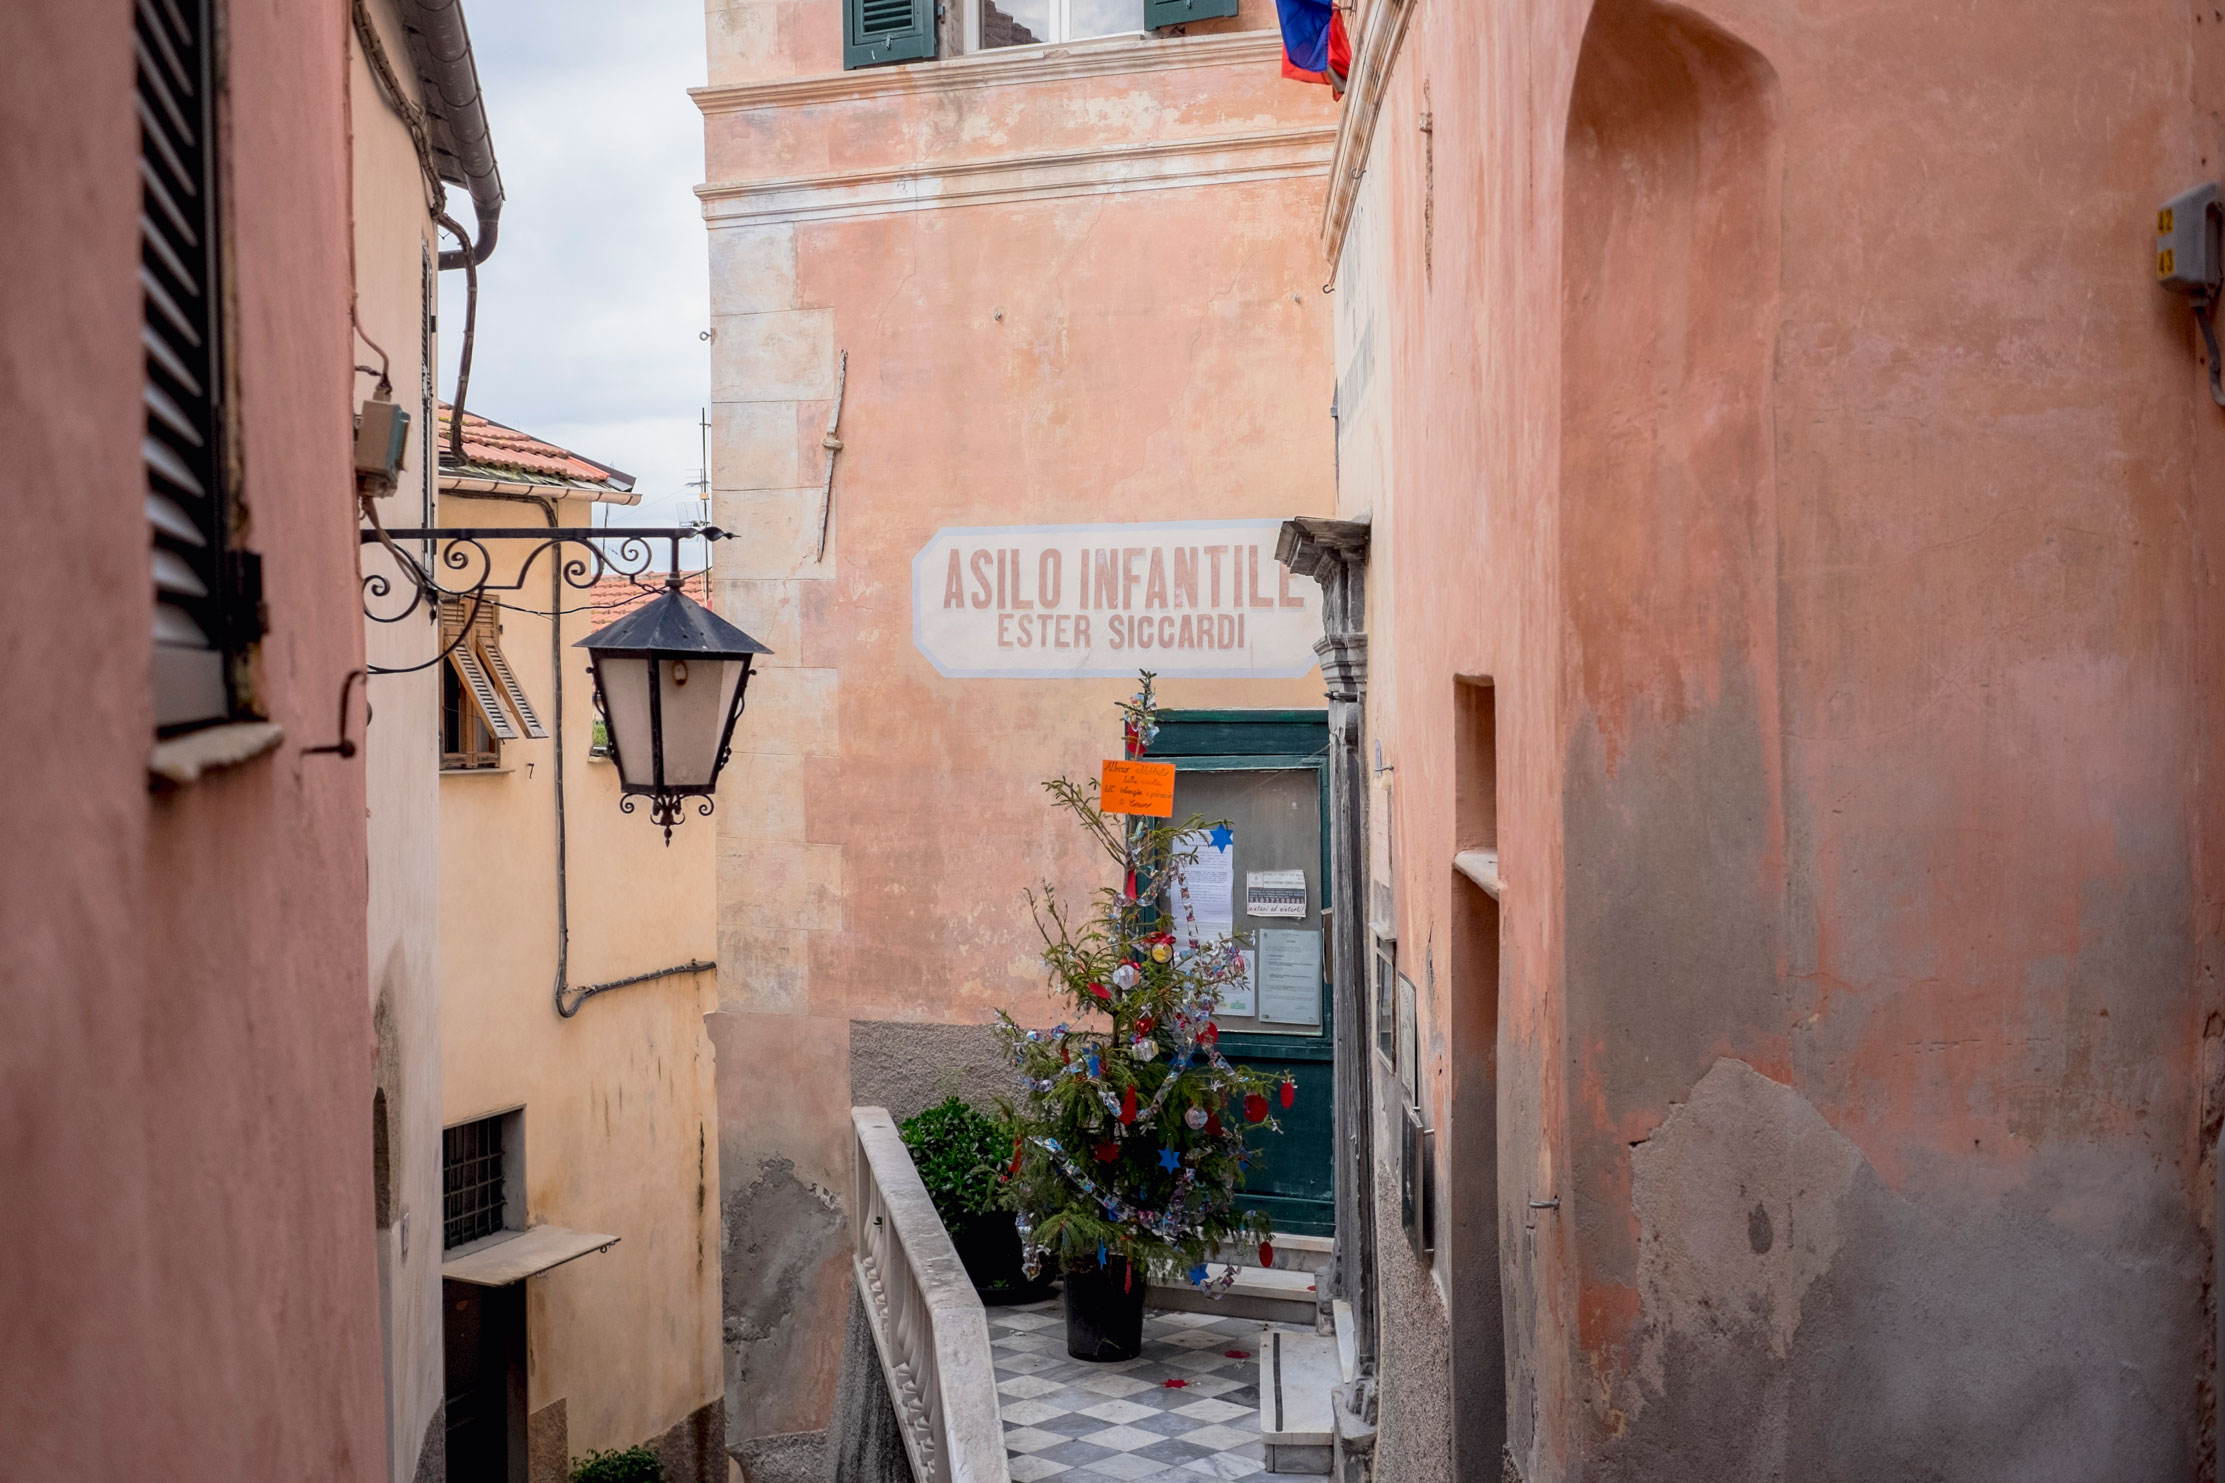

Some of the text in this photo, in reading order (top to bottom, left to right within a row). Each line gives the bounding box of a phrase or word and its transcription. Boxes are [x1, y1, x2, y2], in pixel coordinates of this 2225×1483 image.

[943, 545, 1304, 610] ASILO INFANTILE
[997, 613, 1245, 649] ESTER SICCARDI
